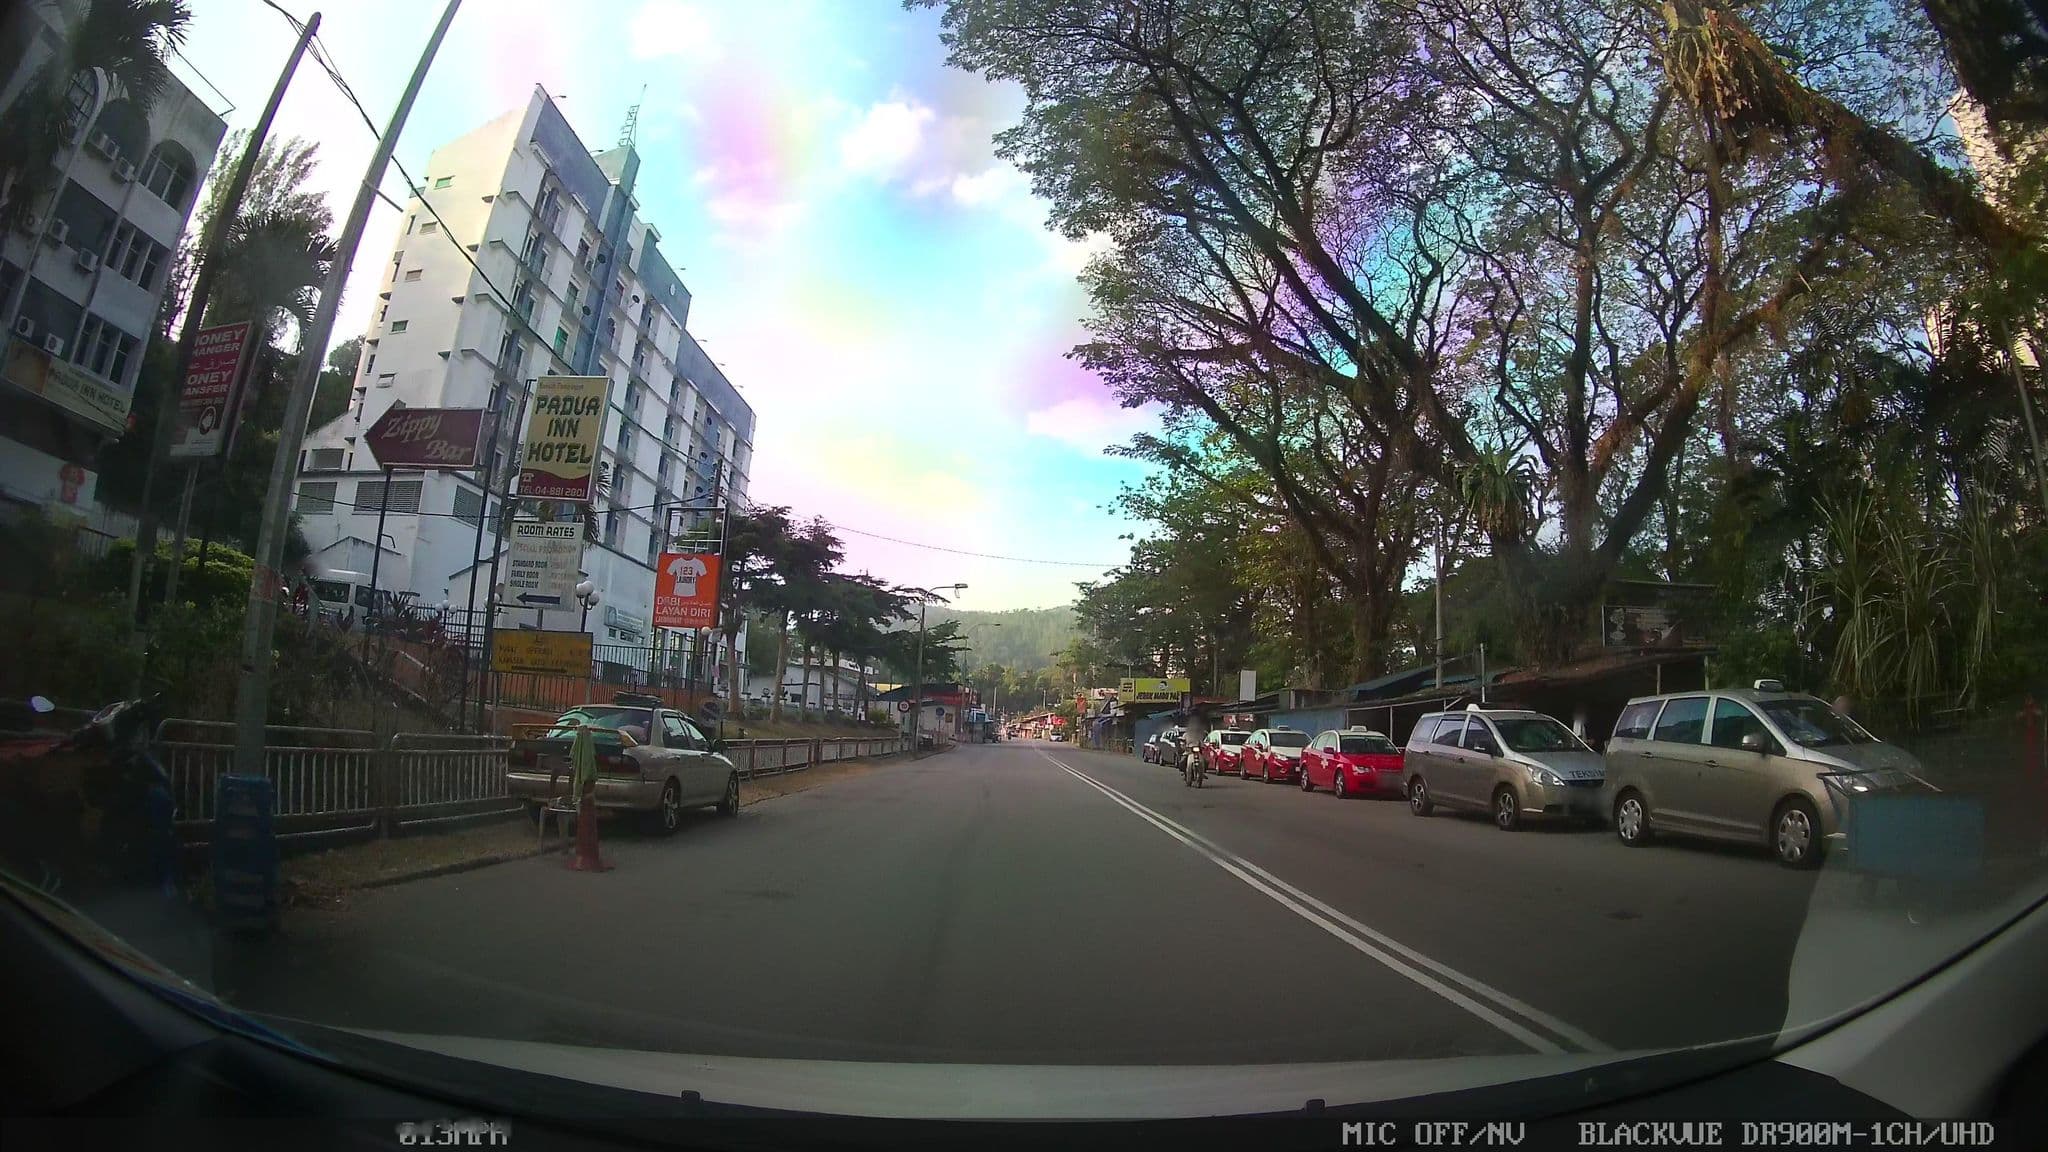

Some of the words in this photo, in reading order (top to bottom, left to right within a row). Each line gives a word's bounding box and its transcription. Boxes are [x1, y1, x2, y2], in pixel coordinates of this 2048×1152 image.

[191, 342, 241, 357] HANGER
[187, 370, 232, 385] ONEY
[535, 395, 601, 416] PADUA
[381, 414, 443, 443] Zippy
[547, 418, 580, 438] INN
[423, 440, 472, 460] Bar
[528, 441, 593, 464] HOTEL
[517, 525, 544, 536] ROOM
[546, 526, 575, 537] RATES
[680, 566, 693, 575] 123
[656, 606, 688, 616] LAYAN
[690, 608, 711, 618] DIRI
